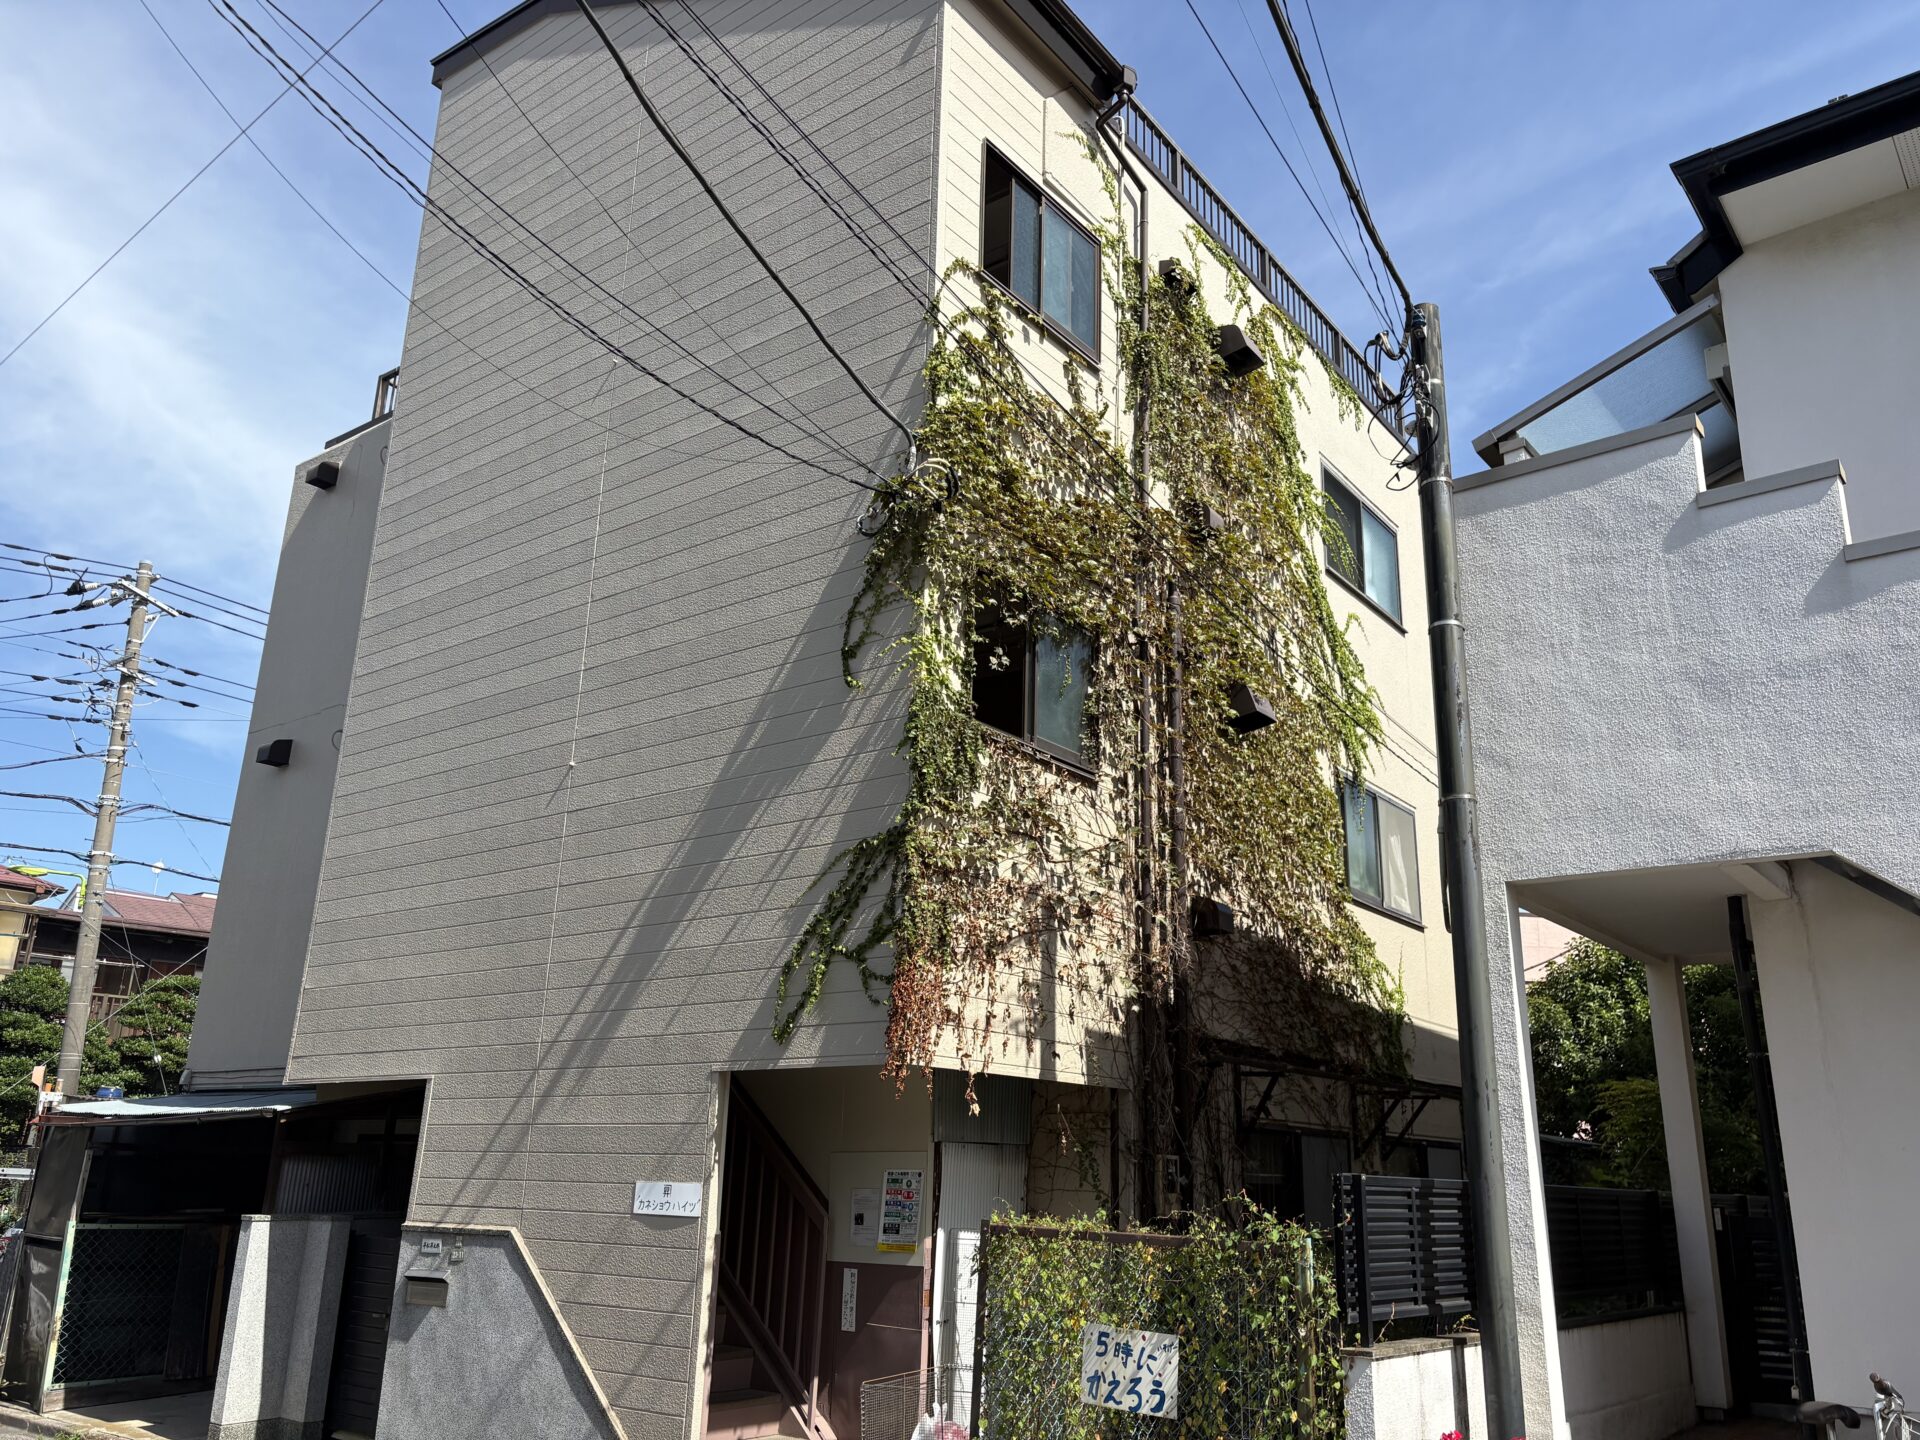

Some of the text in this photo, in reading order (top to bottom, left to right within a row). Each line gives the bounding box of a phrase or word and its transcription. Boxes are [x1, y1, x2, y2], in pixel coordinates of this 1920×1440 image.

[1095, 1331, 1158, 1375] 5時に
[1086, 1369, 1166, 1413] かえろう
